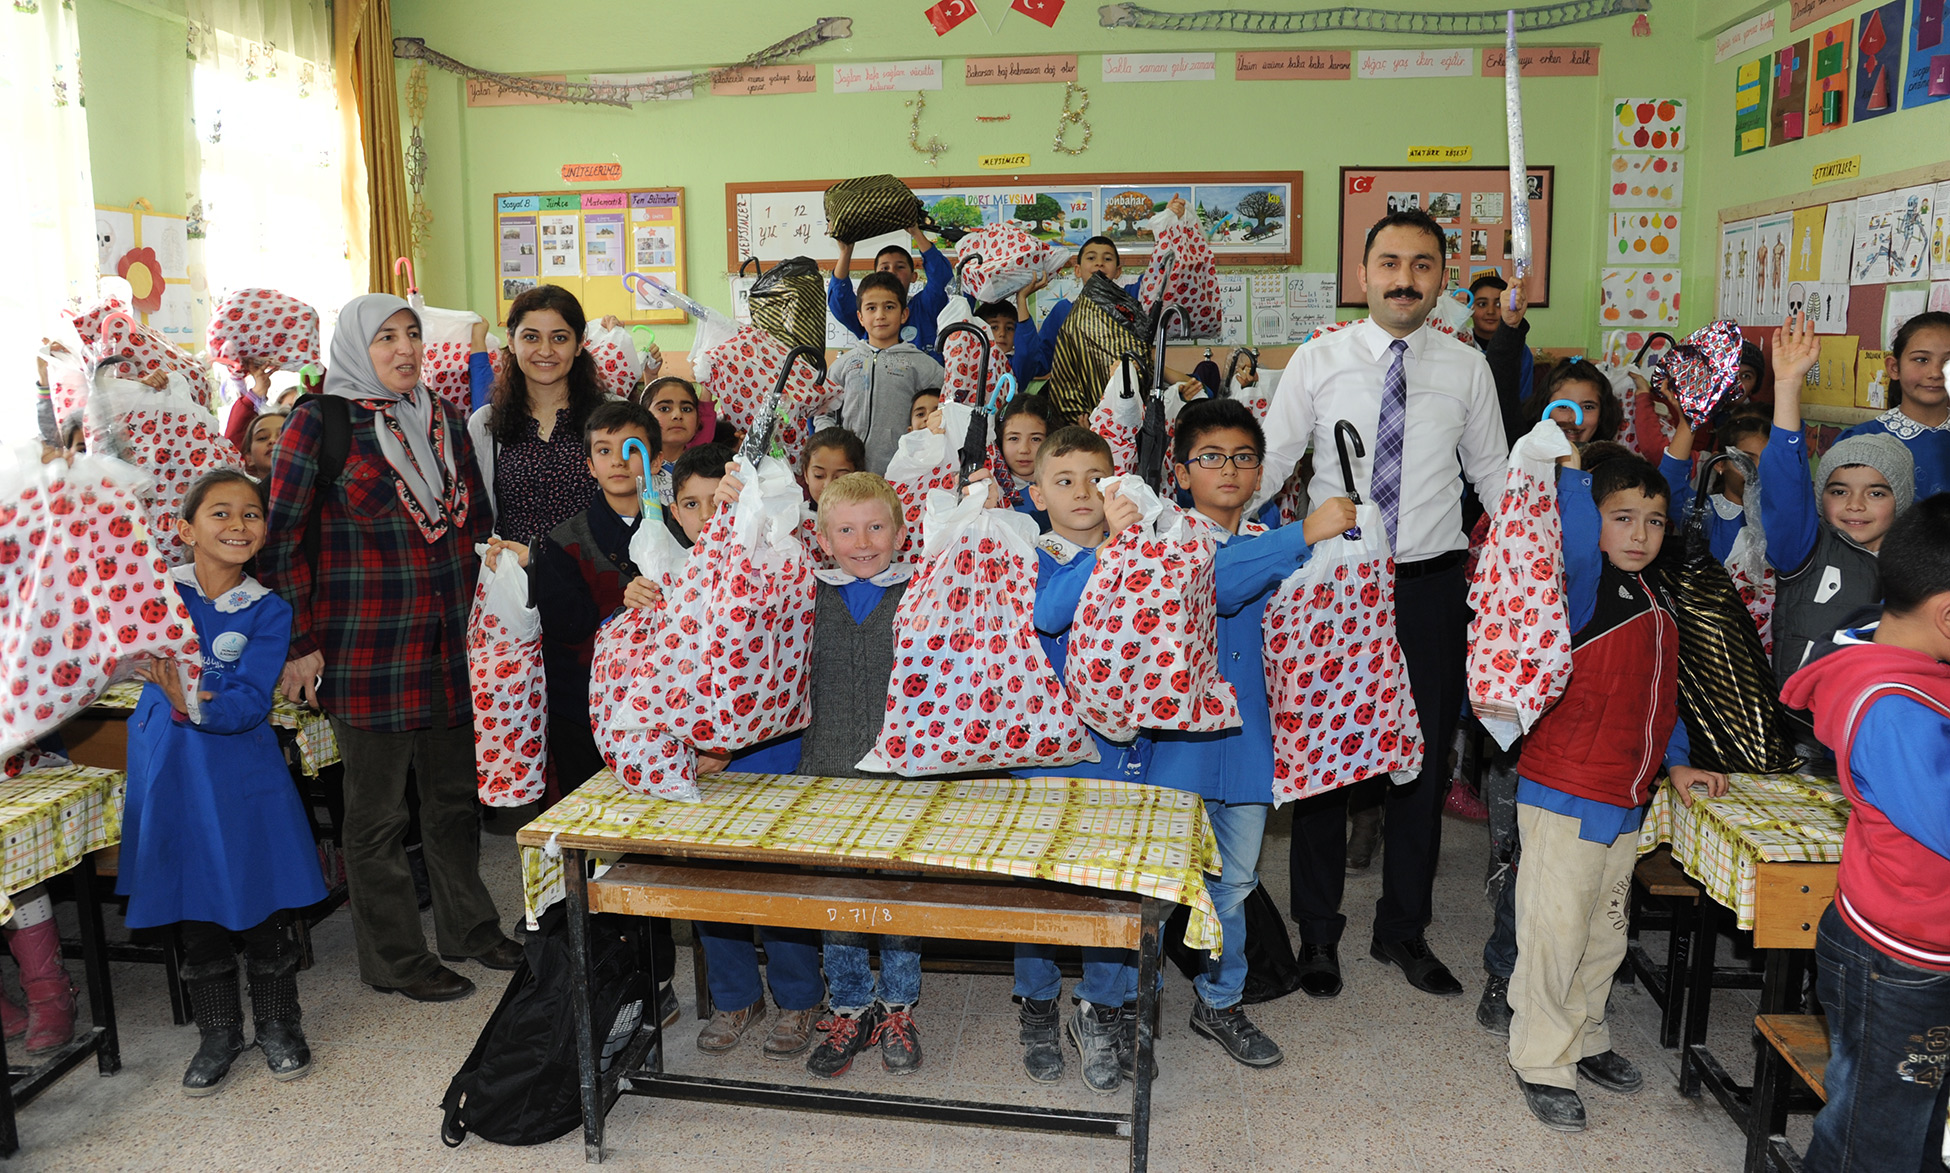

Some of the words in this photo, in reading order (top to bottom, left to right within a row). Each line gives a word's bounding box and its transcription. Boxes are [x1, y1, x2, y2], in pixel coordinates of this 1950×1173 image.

[1052, 81, 1092, 156] B
[585, 196, 623, 207] Matematik
[632, 194, 645, 206] Fen
[1104, 195, 1147, 207] sonbahar
[793, 204, 808, 217] 12
[1070, 202, 1088, 213] yaz
[1288, 279, 1304, 291] 673
[1908, 1052, 1950, 1065] SPOR
